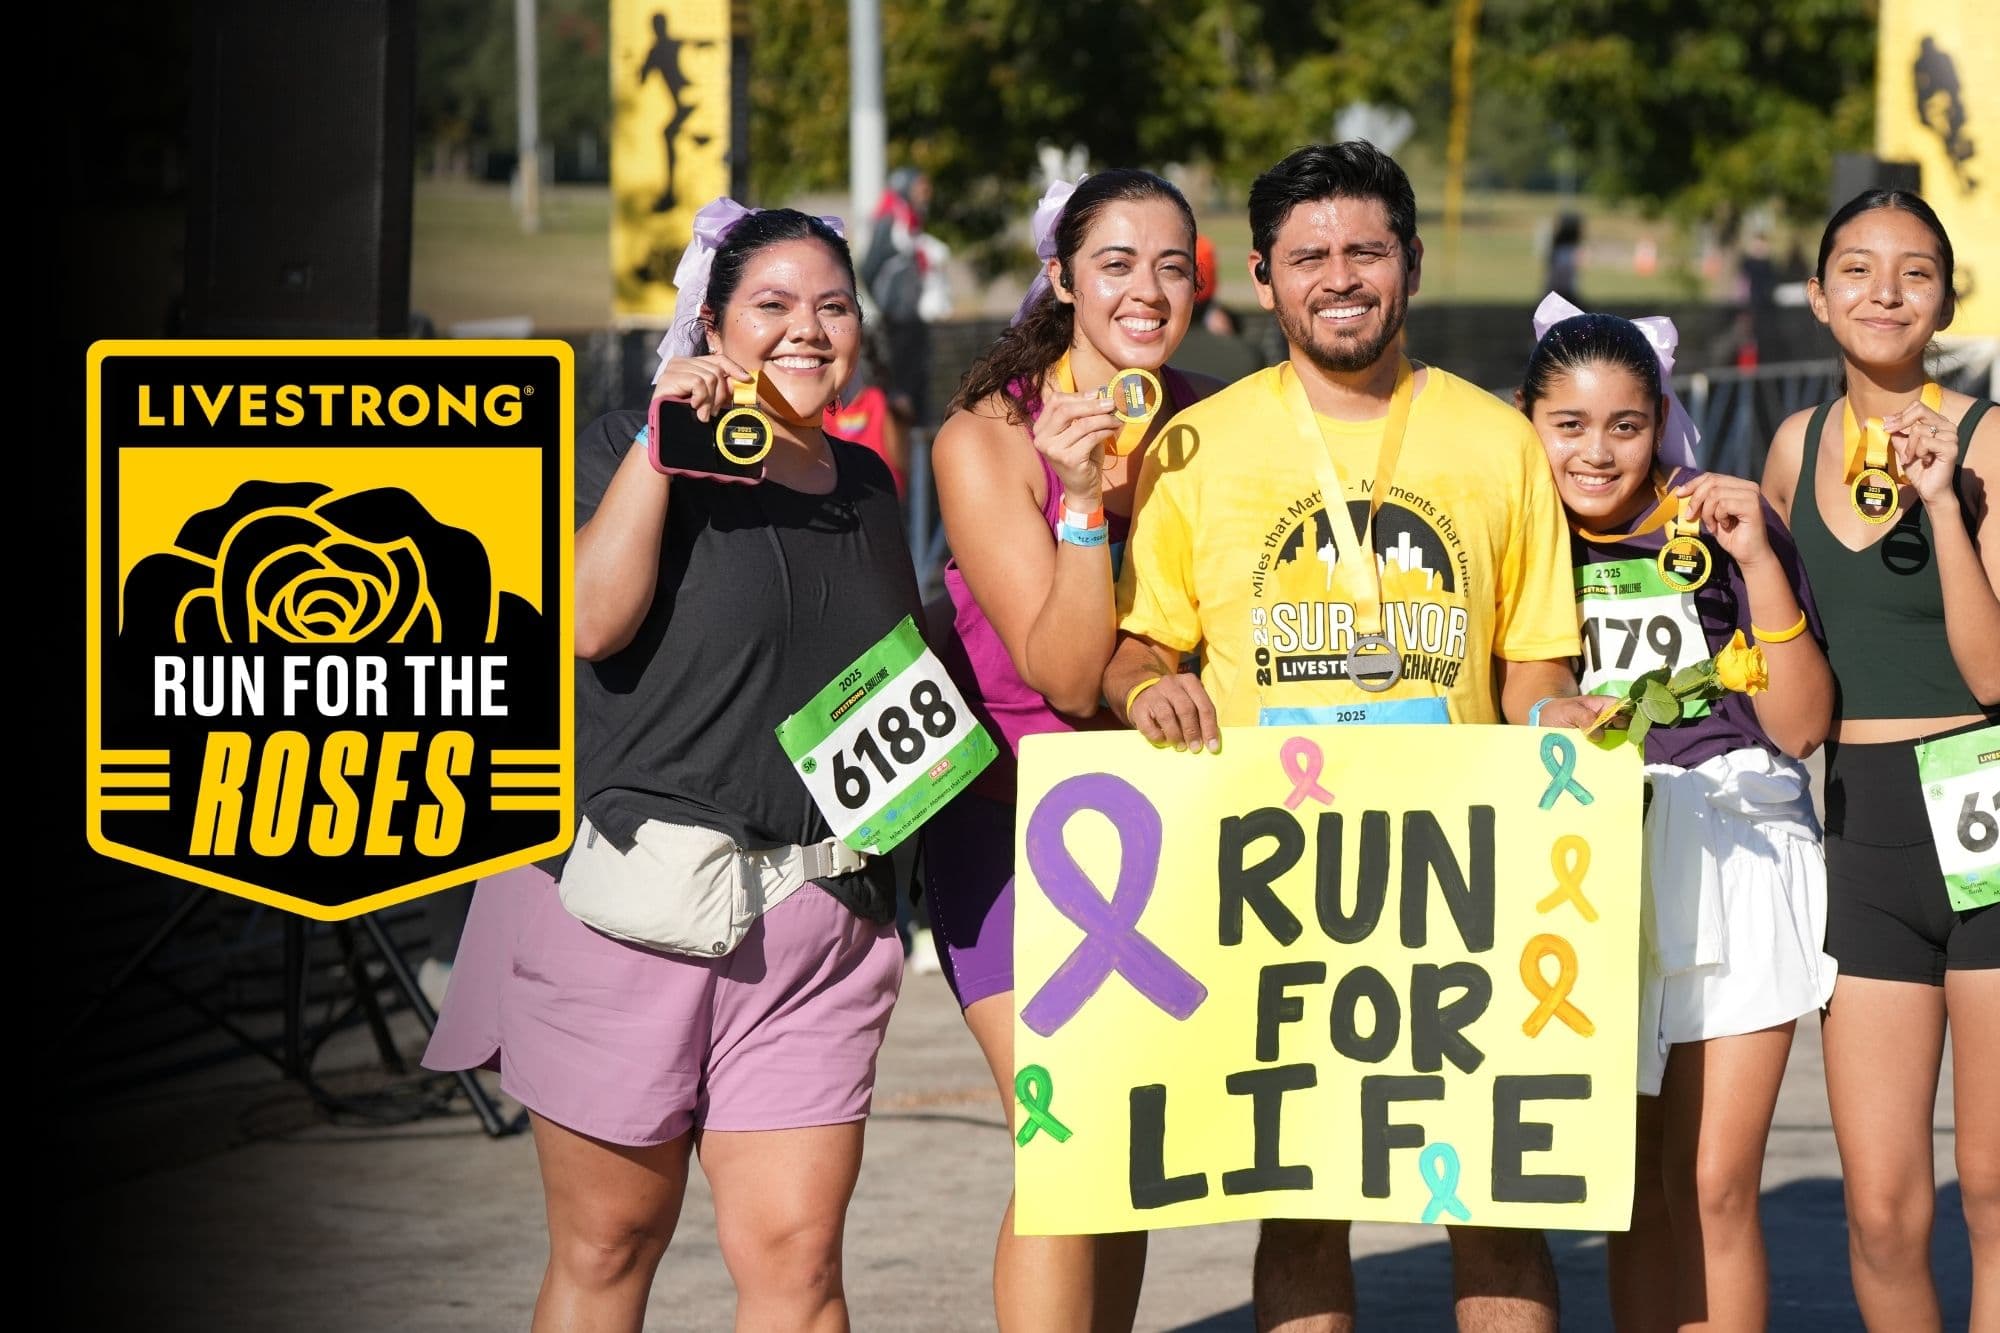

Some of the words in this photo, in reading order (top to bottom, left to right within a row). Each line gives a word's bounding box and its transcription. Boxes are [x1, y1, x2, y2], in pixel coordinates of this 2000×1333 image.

[1252, 553, 1271, 598] Miles
[1264, 517, 1291, 548] that
[1287, 490, 1322, 518] Mat
[1361, 479, 1437, 516] Mments
[1437, 515, 1460, 548] that
[1596, 568, 1621, 578] 2025
[1251, 607, 1272, 686] 2025
[1271, 602, 1469, 660] SURIVOR
[839, 668, 862, 692] 2025
[1282, 660, 1348, 677] LIVESTR
[832, 689, 865, 720] LIVESTRONG
[1337, 711, 1365, 723] 2025
[803, 759, 816, 772] 5K
[833, 680, 956, 809] 6188
[1219, 806, 1495, 952] RUN
[1256, 961, 1493, 1074] FOR
[1130, 1063, 1592, 1210] LIFE
